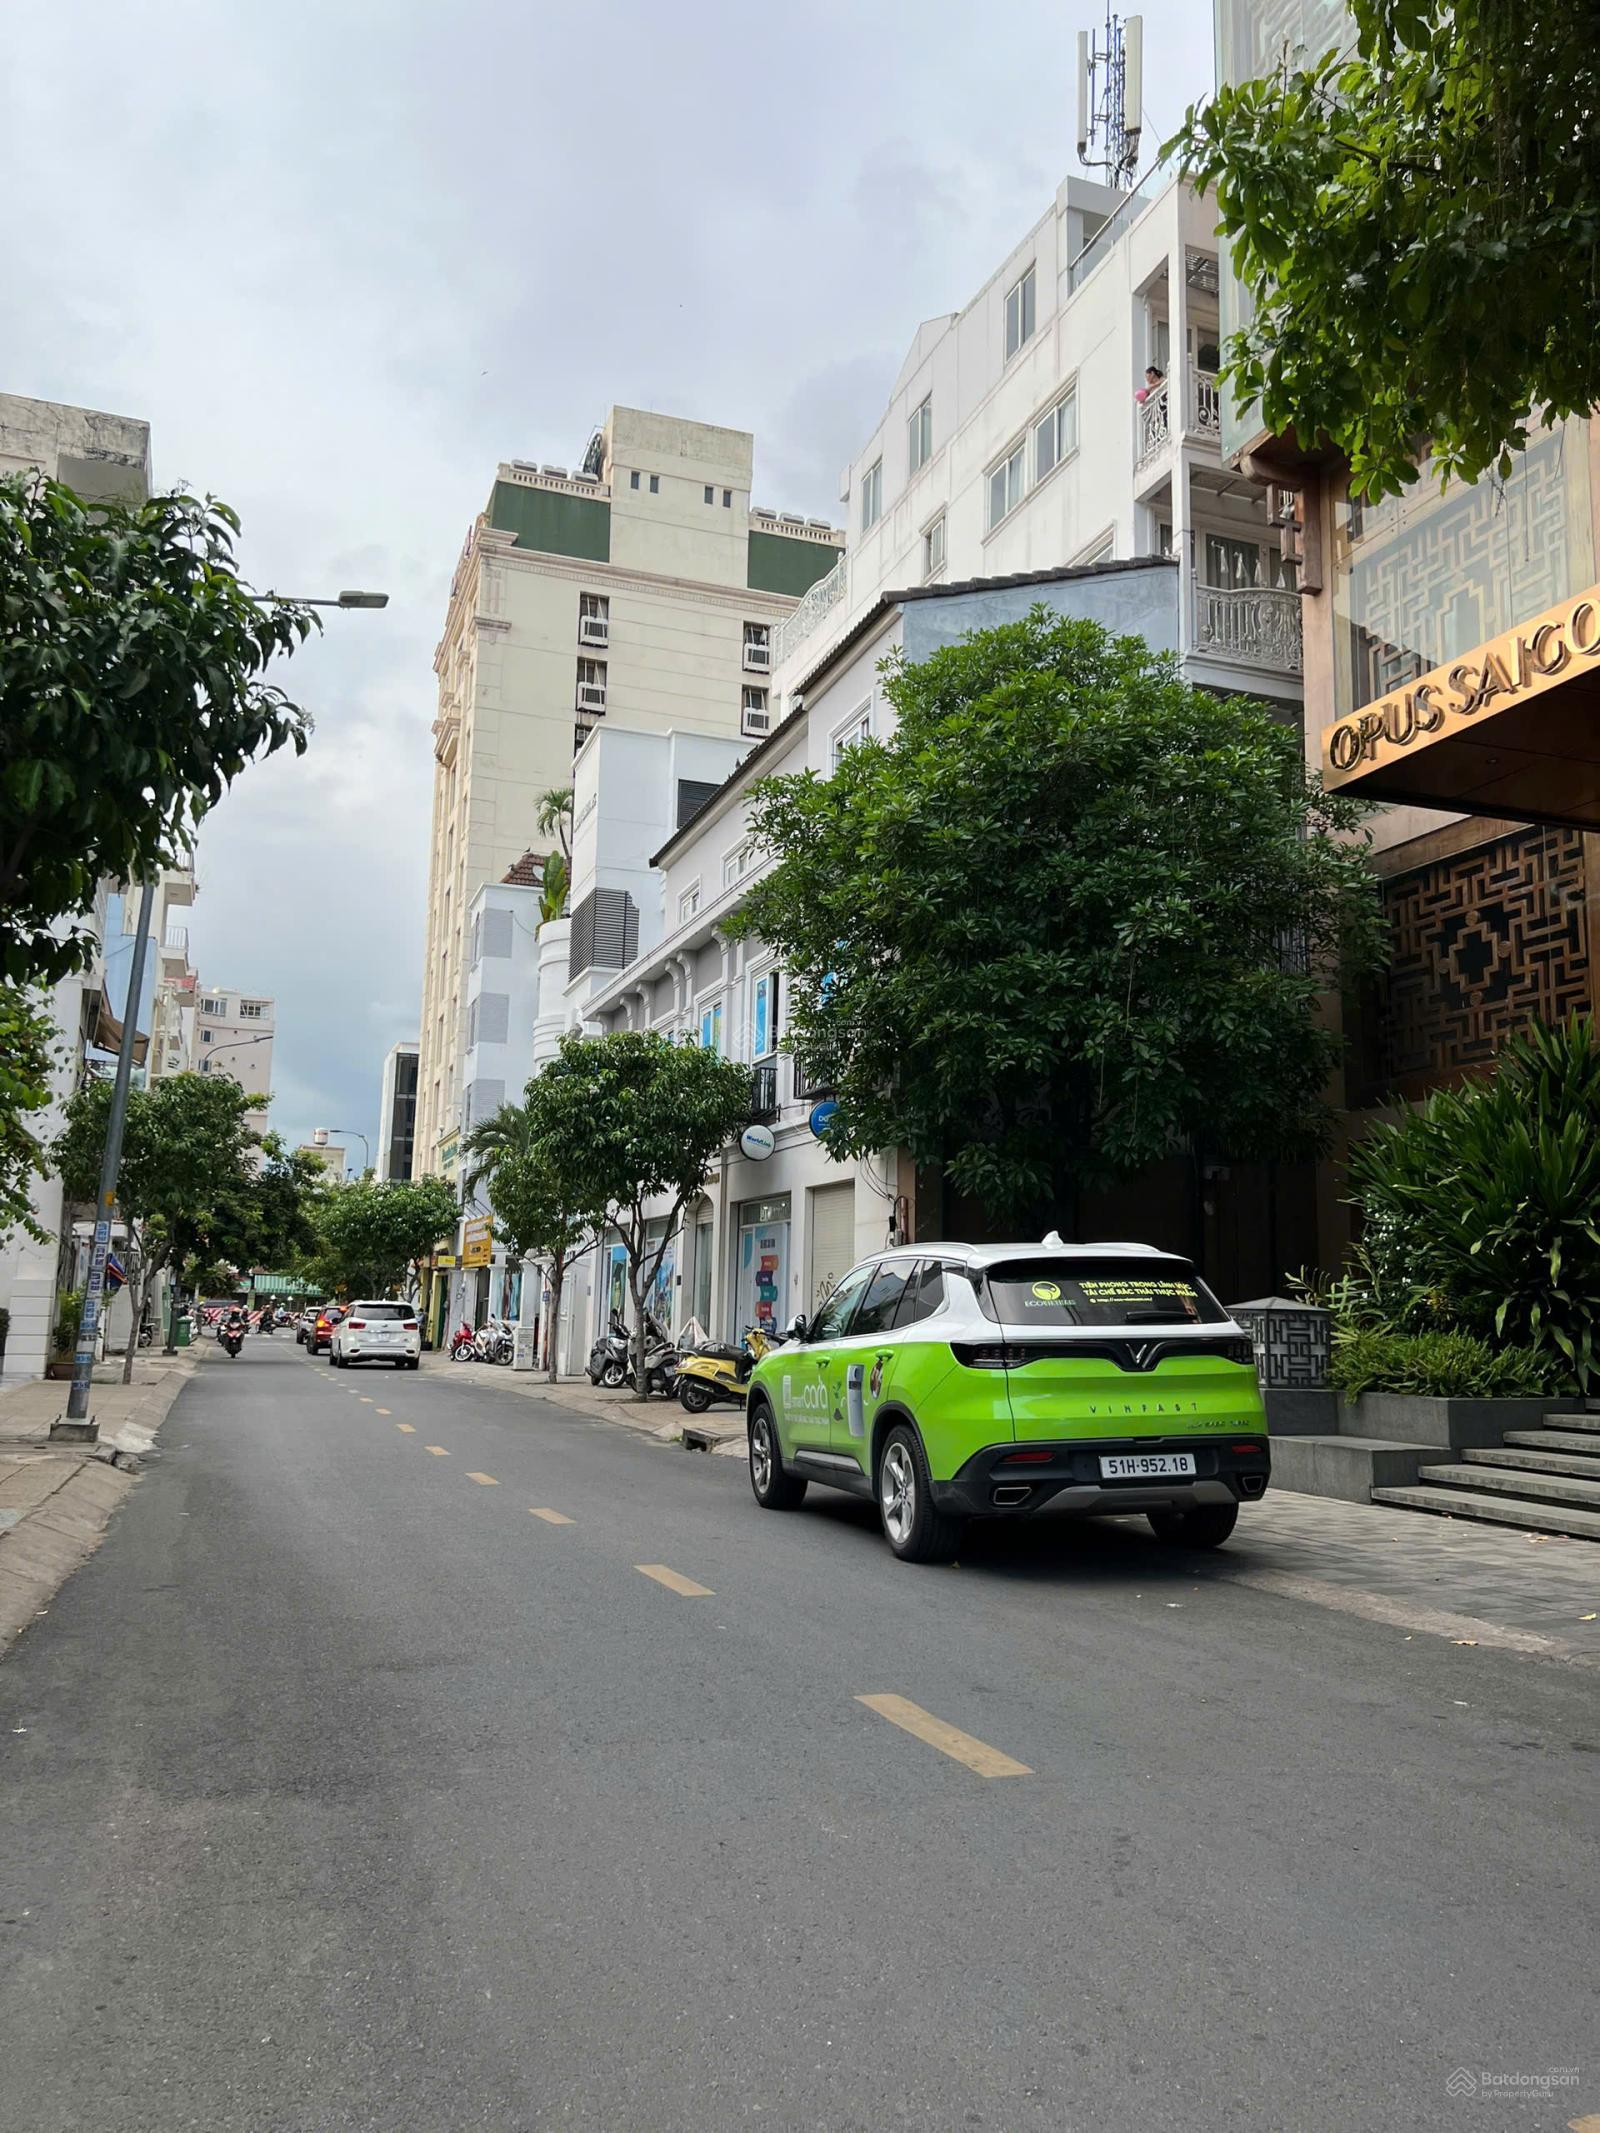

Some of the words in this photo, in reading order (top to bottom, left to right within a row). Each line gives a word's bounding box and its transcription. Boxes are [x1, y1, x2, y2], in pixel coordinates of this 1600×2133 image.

[1329, 683, 1445, 771] OPUS
[1099, 1281, 1128, 1289] PHONG
[1128, 1281, 1158, 1289] TRONG
[1089, 1402, 1198, 1414] VINFAST
[1108, 1457, 1188, 1475] 51H-952.18
